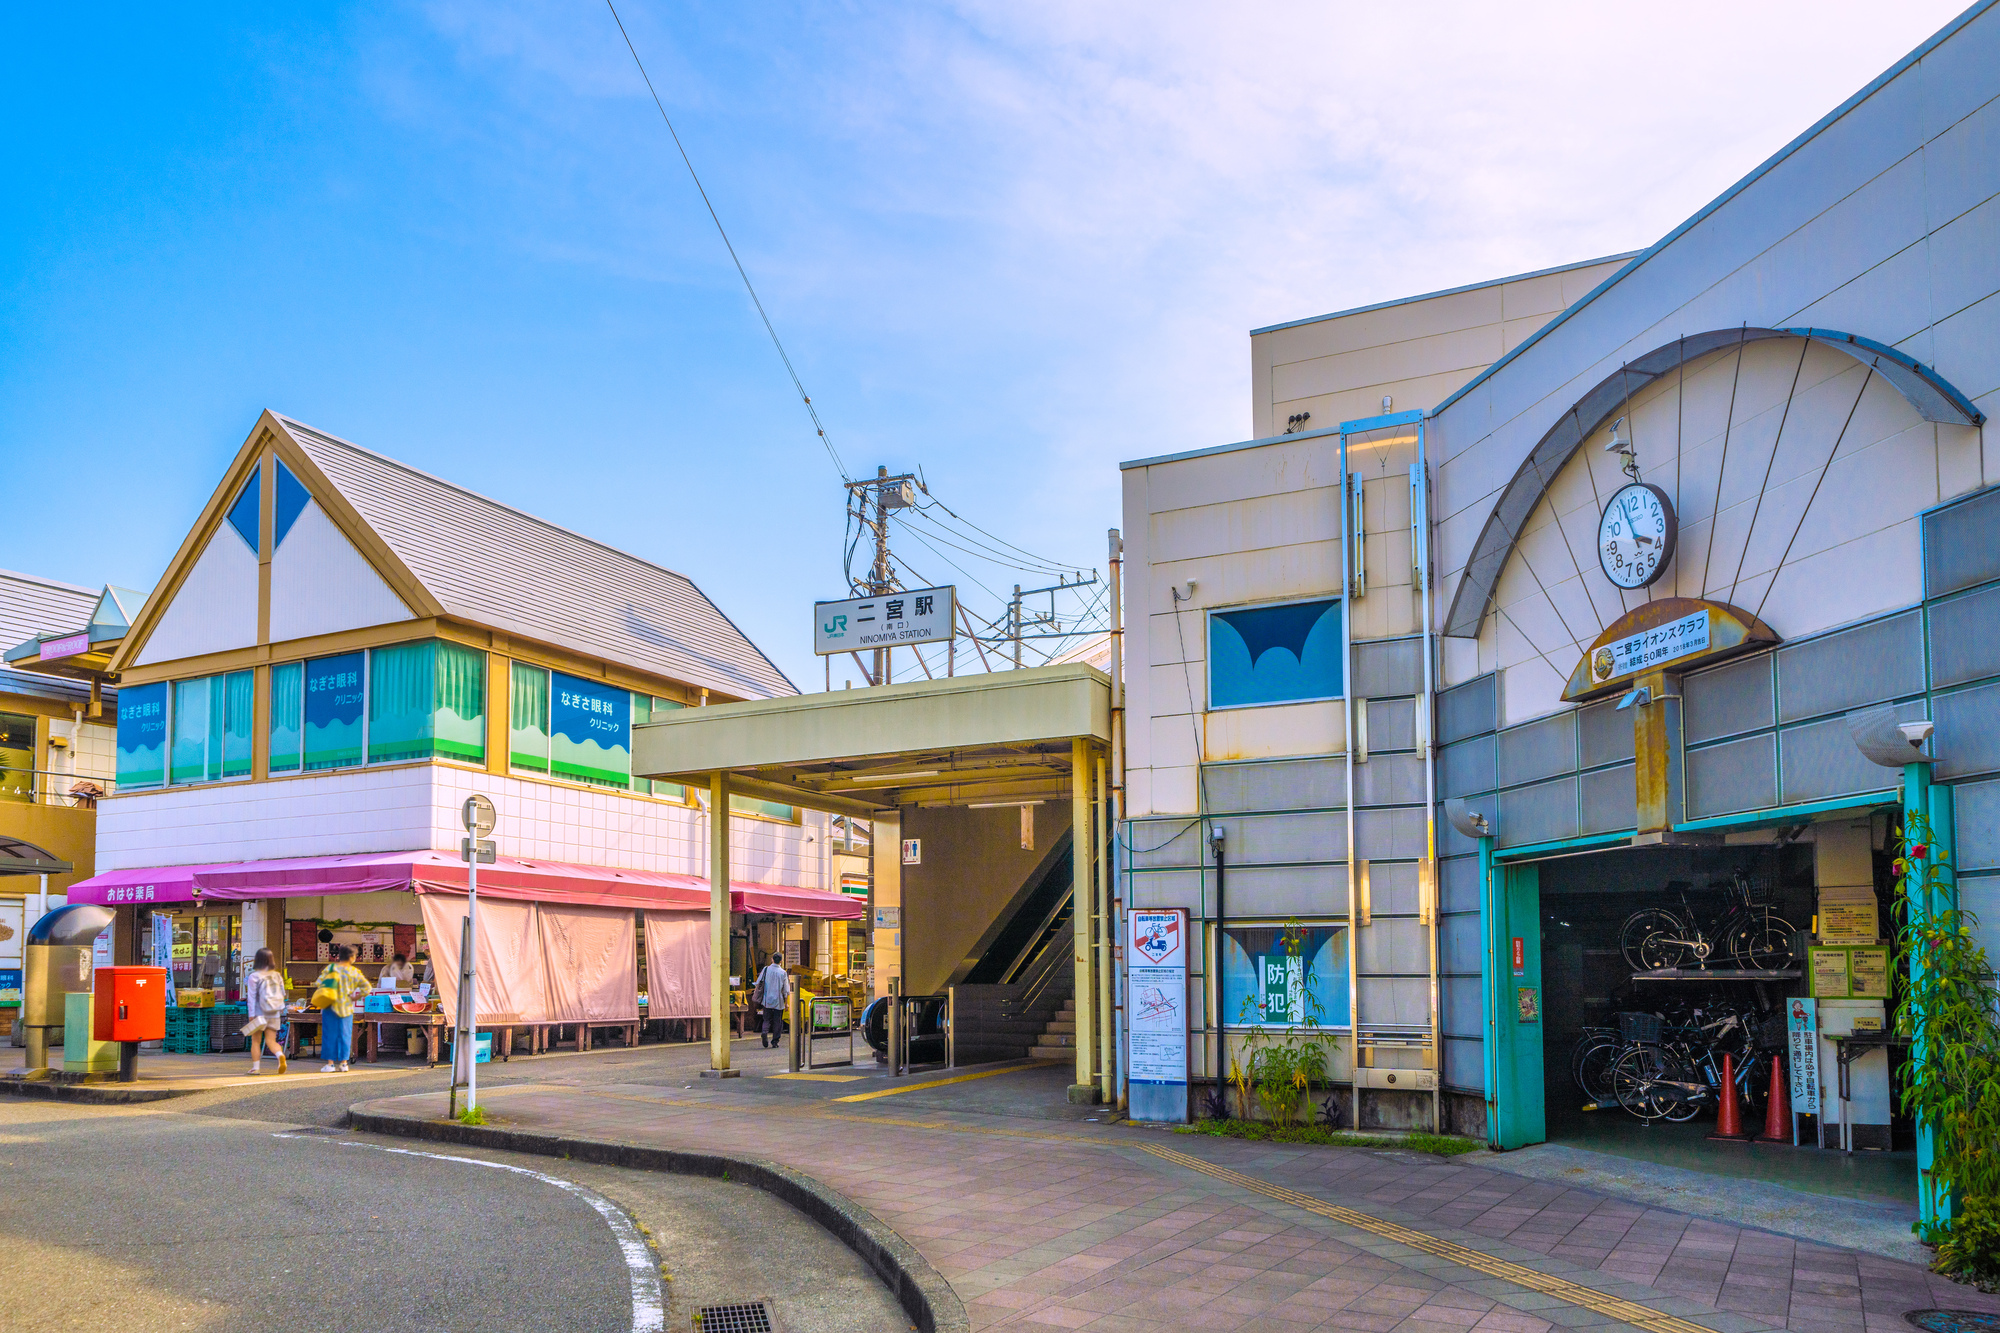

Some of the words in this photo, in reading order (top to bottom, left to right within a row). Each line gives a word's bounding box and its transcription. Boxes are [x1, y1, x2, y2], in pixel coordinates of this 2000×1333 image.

[1627, 496, 1639, 513] 12
[1643, 495, 1647, 510] 1
[1650, 502, 1659, 518] 2
[1610, 521, 1621, 538] 10
[1656, 518, 1665, 533] 3
[1610, 541, 1618, 556] 9
[1655, 536, 1663, 551] 4
[1616, 554, 1624, 568] 8
[1648, 552, 1656, 568] 5
[1625, 562, 1633, 578] 7
[1636, 562, 1645, 578] 6
[857, 595, 934, 623] 二宮駅
[824, 614, 848, 633] JR
[860, 632, 897, 645] NINOMIYA
[900, 628, 932, 640] STATION
[1616, 616, 1705, 658] 二宮ライオンズクラブ
[1629, 646, 1669, 668] 結成50周年
[308, 671, 358, 692] なぎさ眼科
[334, 692, 364, 706] クリニック
[560, 691, 613, 716] なぎさ眼科
[120, 701, 160, 720] なぎさ眼科
[141, 720, 165, 732] クリニック
[589, 717, 620, 733] クリニック
[106, 885, 155, 902] おはな薬局
[1267, 963, 1286, 1013] 防犯
